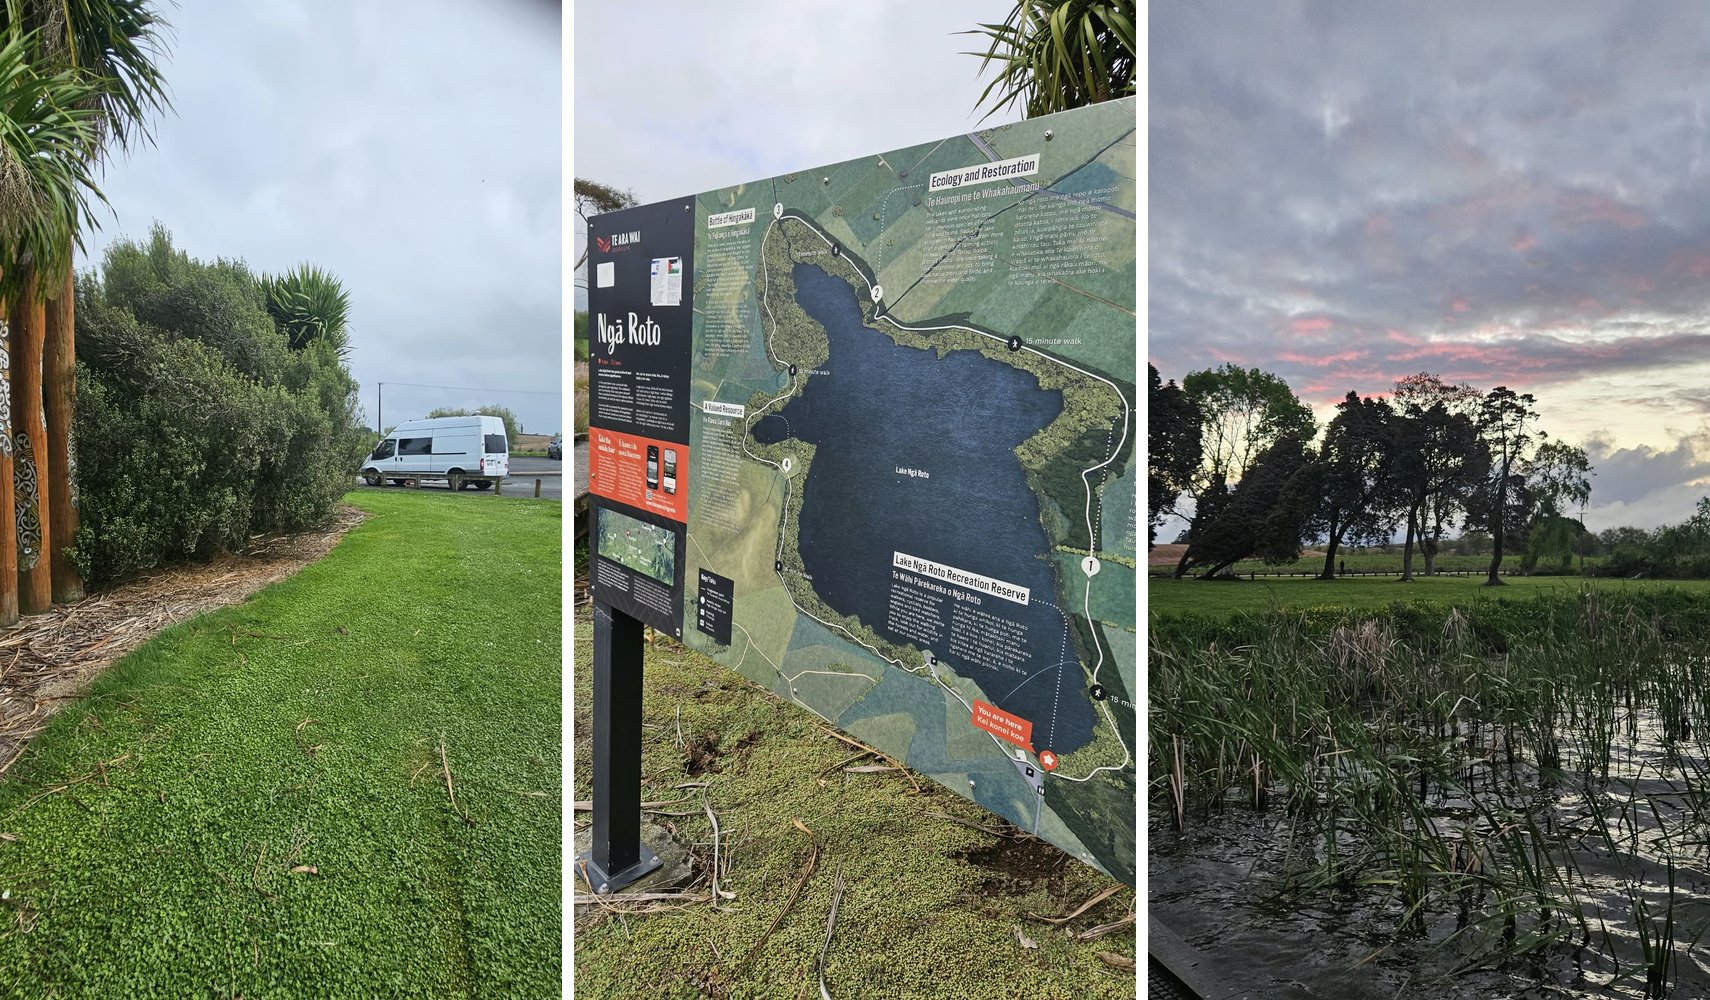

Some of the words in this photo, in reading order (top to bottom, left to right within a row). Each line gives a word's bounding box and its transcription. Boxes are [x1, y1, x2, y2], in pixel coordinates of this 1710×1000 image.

[932, 174, 963, 187] Ecology
[964, 168, 980, 182] and
[982, 160, 1035, 179] Restoration
[928, 198, 936, 207] Te
[936, 193, 961, 206] Hauropi
[962, 193, 972, 201] me
[973, 191, 980, 199] te
[982, 183, 1040, 199] Whakahaumanu
[777, 205, 781, 214] 3
[612, 234, 618, 246] TE
[618, 233, 628, 245] ARA
[629, 230, 640, 243] WAI
[874, 288, 879, 298] 2
[598, 313, 626, 355] Ngā
[628, 312, 661, 346] Roto
[708, 403, 721, 412] Valued
[723, 405, 742, 415] Resource
[896, 466, 907, 474] Lake
[918, 470, 929, 478] Roto
[895, 555, 911, 568] Lake
[913, 560, 927, 573] Ngā
[928, 564, 946, 578] Roto
[947, 570, 989, 590] Recreation
[992, 582, 1026, 601] Reserve
[1088, 561, 1093, 571] 1
[892, 570, 899, 579] Te
[900, 572, 913, 583] Wāhi
[914, 577, 946, 595] Pārekareka
[953, 589, 965, 600] Ngā
[966, 593, 981, 605] Roto
[977, 716, 989, 727] Kei
[990, 719, 1009, 735] konei
[1010, 729, 1024, 742] koe
[978, 706, 991, 717] You
[992, 712, 1004, 724] are
[1006, 716, 1022, 731] here
